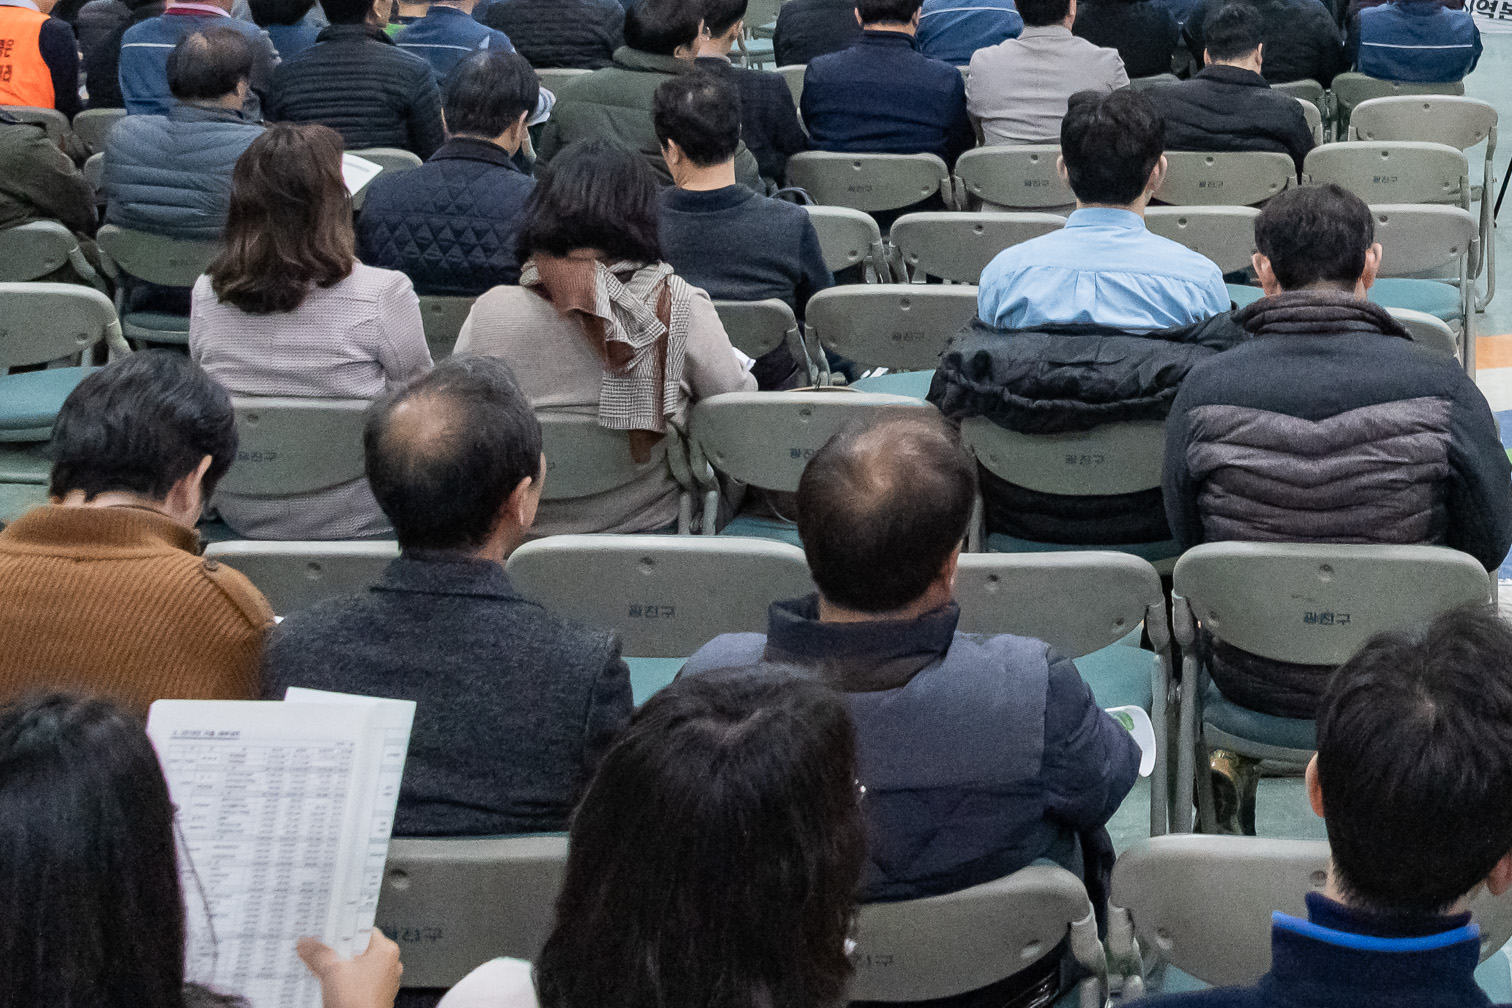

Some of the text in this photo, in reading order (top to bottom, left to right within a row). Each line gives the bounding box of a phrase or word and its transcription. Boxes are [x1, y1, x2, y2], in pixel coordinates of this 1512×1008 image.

[789, 448, 815, 460] 광진
[628, 605, 676, 619] 광진구
[1303, 611, 1352, 626] 광진구
